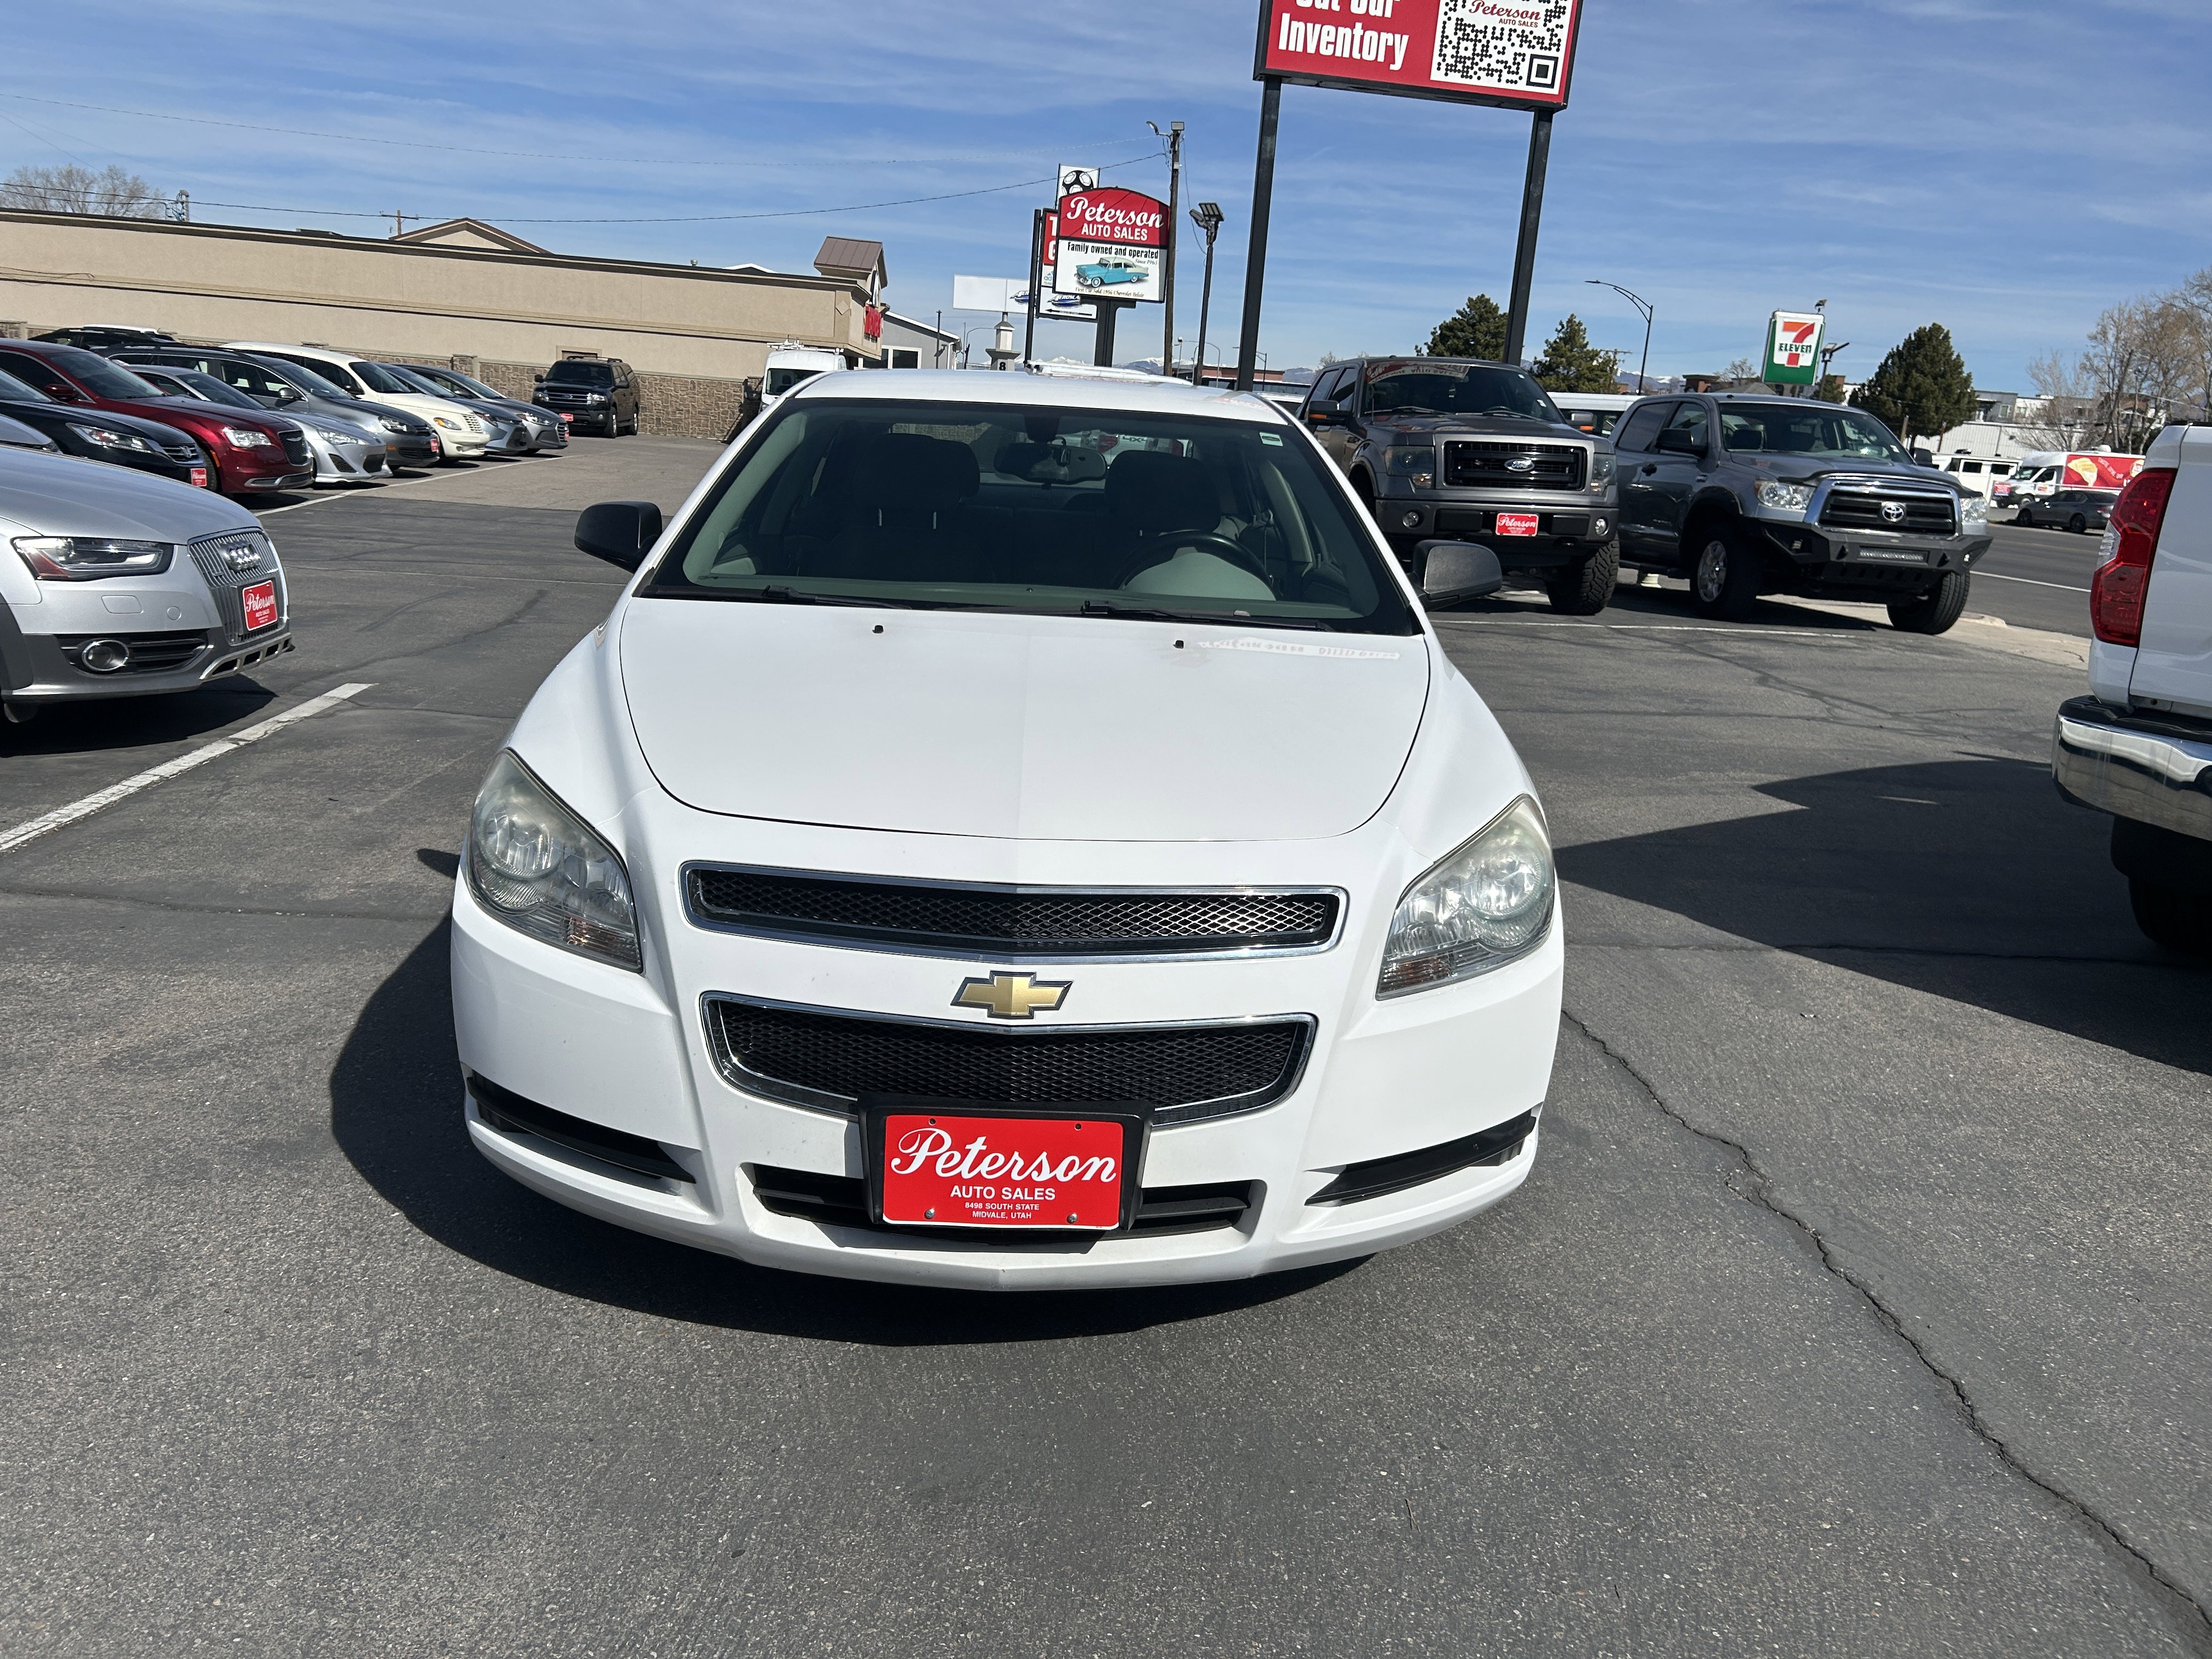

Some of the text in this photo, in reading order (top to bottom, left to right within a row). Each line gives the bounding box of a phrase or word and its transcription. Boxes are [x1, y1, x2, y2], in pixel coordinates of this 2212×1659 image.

[1469, 0, 1541, 20] Peterson
[1278, 13, 1409, 71] Inventory
[1066, 196, 1164, 228] Peterson
[1081, 223, 1148, 241] AUTO SALES
[1068, 242, 1159, 259] Family owned and operated
[1782, 321, 1815, 366] 7
[999, 362, 1006, 371] 8
[1498, 516, 1536, 527] Peterson
[246, 593, 275, 612] Peterson
[891, 1127, 1117, 1182] Peterson
[950, 1185, 1056, 1200] AUTO SALES
[972, 1211, 1008, 1219] MIDVALE,
